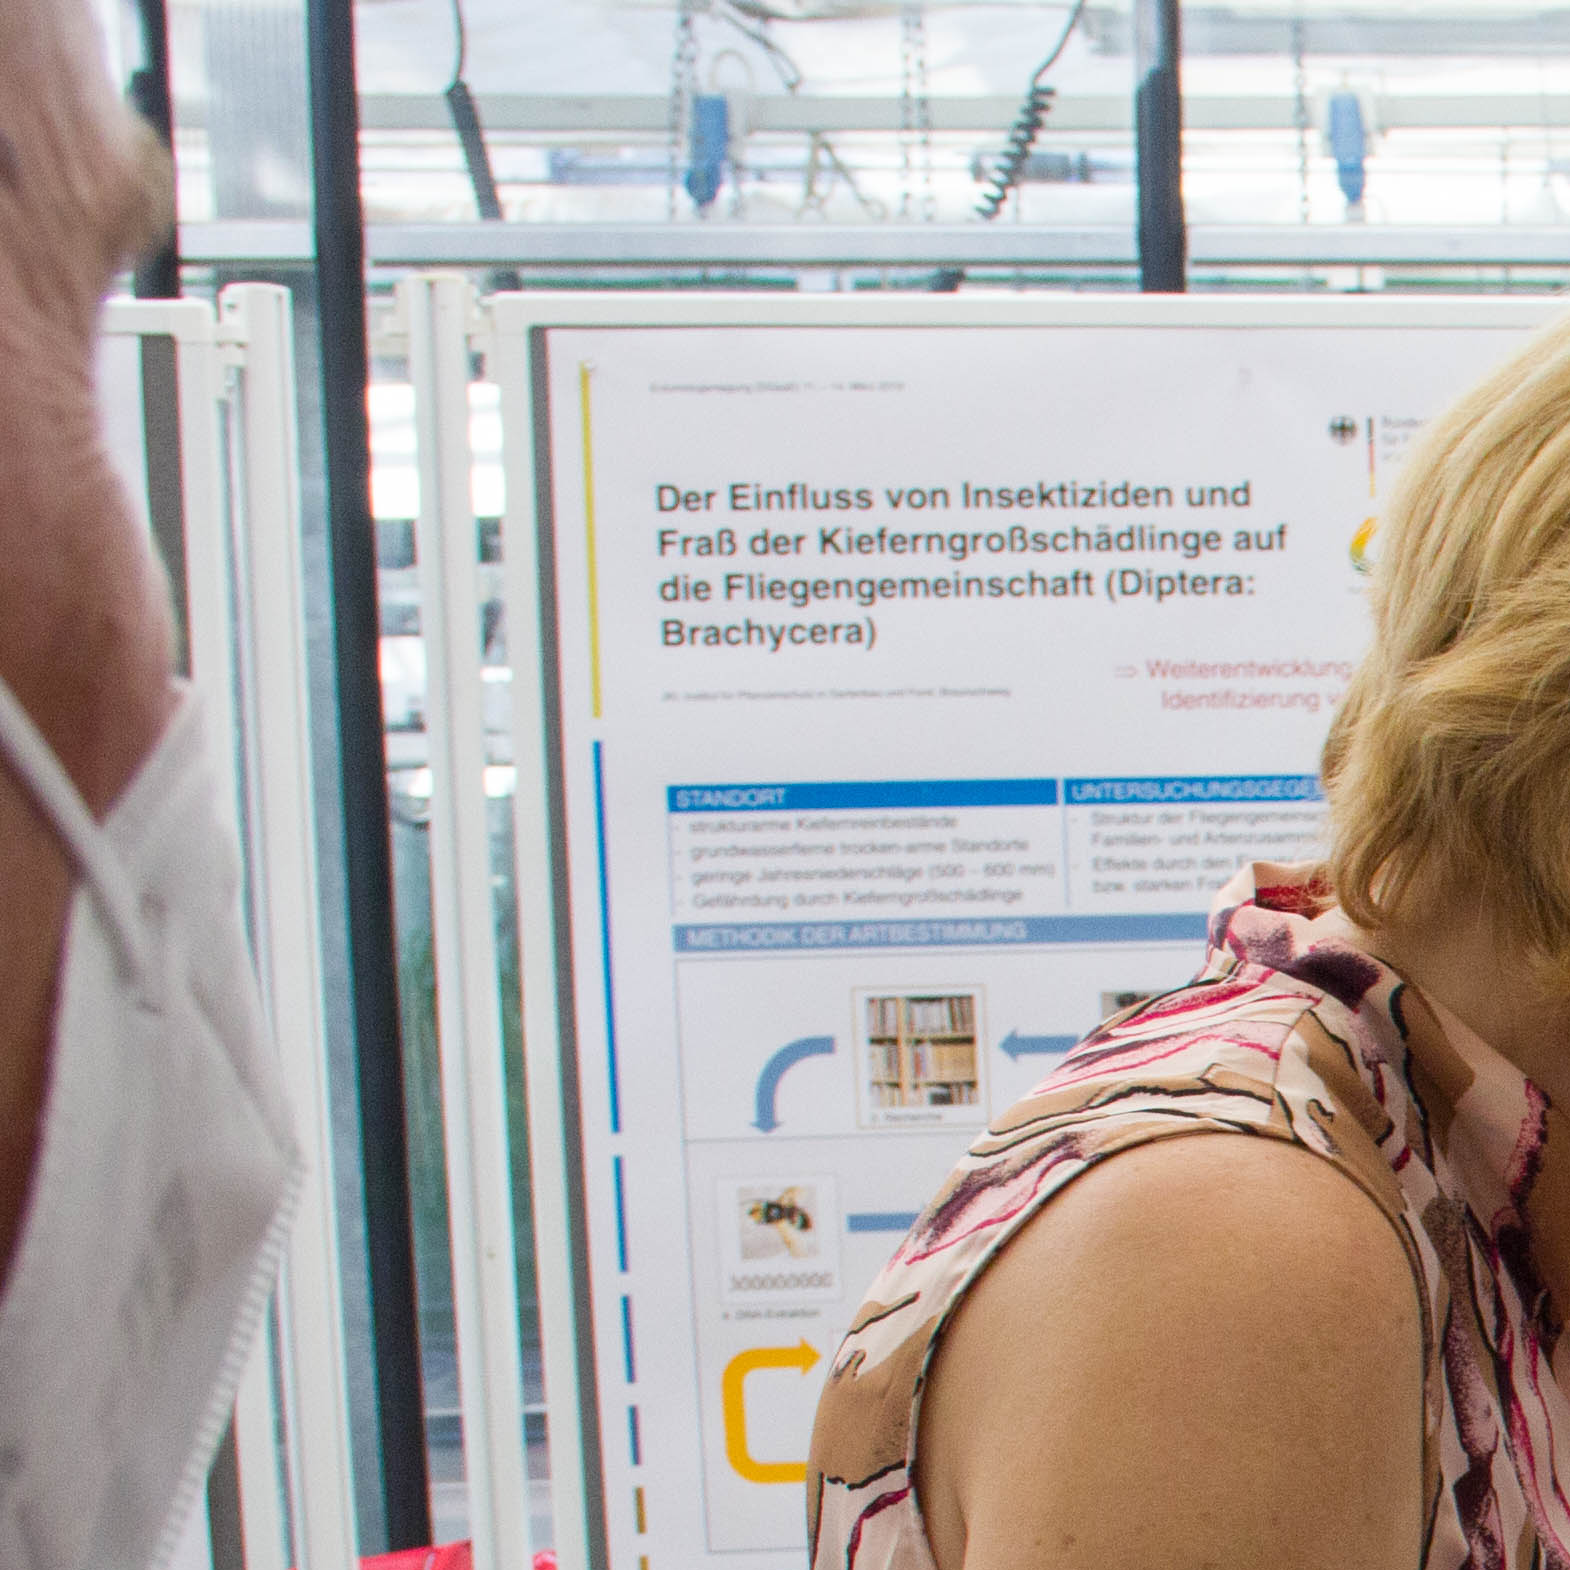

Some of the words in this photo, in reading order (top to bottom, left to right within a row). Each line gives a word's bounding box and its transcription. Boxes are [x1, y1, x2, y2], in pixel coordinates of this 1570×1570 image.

[656, 484, 716, 512] Der
[729, 483, 873, 511] Einfluss
[885, 488, 949, 509] von
[963, 482, 1172, 509] Insektiziden
[1186, 481, 1251, 507] und
[658, 528, 737, 556] Fraß
[749, 529, 806, 556] der
[819, 526, 1222, 560] Kieferngroßschädlinge
[1234, 524, 1286, 551] auf
[659, 575, 711, 602] die
[724, 571, 1093, 607] Fliegengemeinschaft
[1106, 569, 1253, 601] (Diptera:
[661, 618, 876, 651] Brachycera)
[1145, 660, 1356, 686] Weiterentwicklung
[1161, 689, 1320, 713] Identifizierung
[674, 786, 785, 808] STANDORT
[1169, 832, 1200, 846] und
[1152, 858, 1194, 871] durch
[794, 893, 839, 906] durch
[687, 928, 799, 949] METHODIK
[802, 926, 845, 944] DER
[848, 920, 1029, 946] ARTBESTIMMUNG
